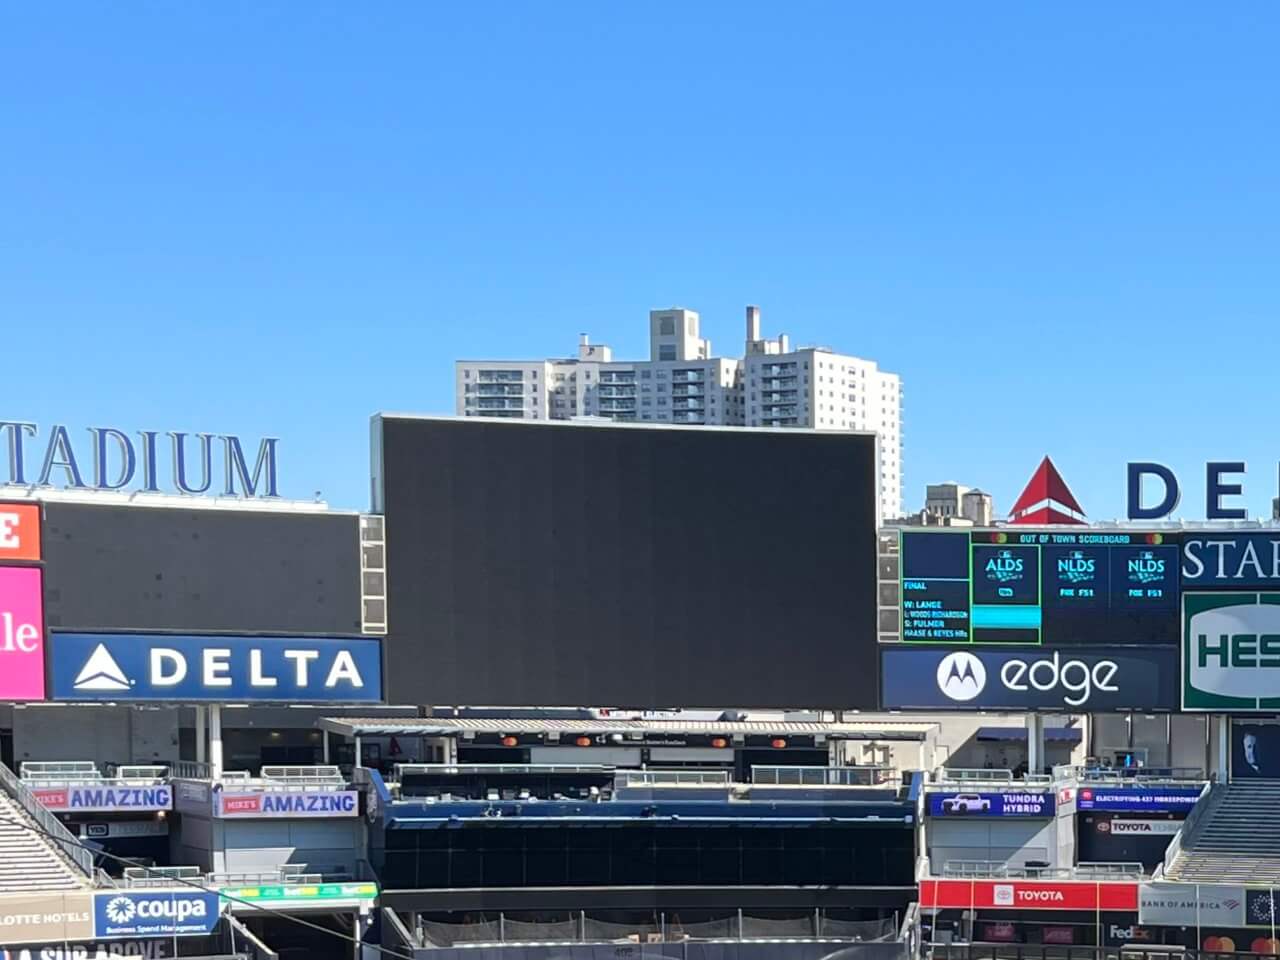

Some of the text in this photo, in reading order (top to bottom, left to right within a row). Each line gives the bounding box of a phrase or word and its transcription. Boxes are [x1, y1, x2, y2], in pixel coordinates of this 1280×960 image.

[1020, 534, 1130, 544] OUT OF TOWN SCOREBOARD
[985, 559, 1023, 571] ALDS
[1058, 560, 1095, 572] NLDS
[1128, 560, 1165, 572] NLDS
[150, 649, 364, 688] DELTA
[1001, 651, 1118, 705] edge
[72, 789, 169, 807] AMAZING
[263, 796, 354, 811] AMAZING
[1003, 795, 1045, 803] TUNDRA
[1017, 891, 1064, 901] TOYOTA
[137, 899, 206, 921] coupa
[43, 912, 89, 923] HOTELS
[1110, 926, 1149, 939] FedEx
